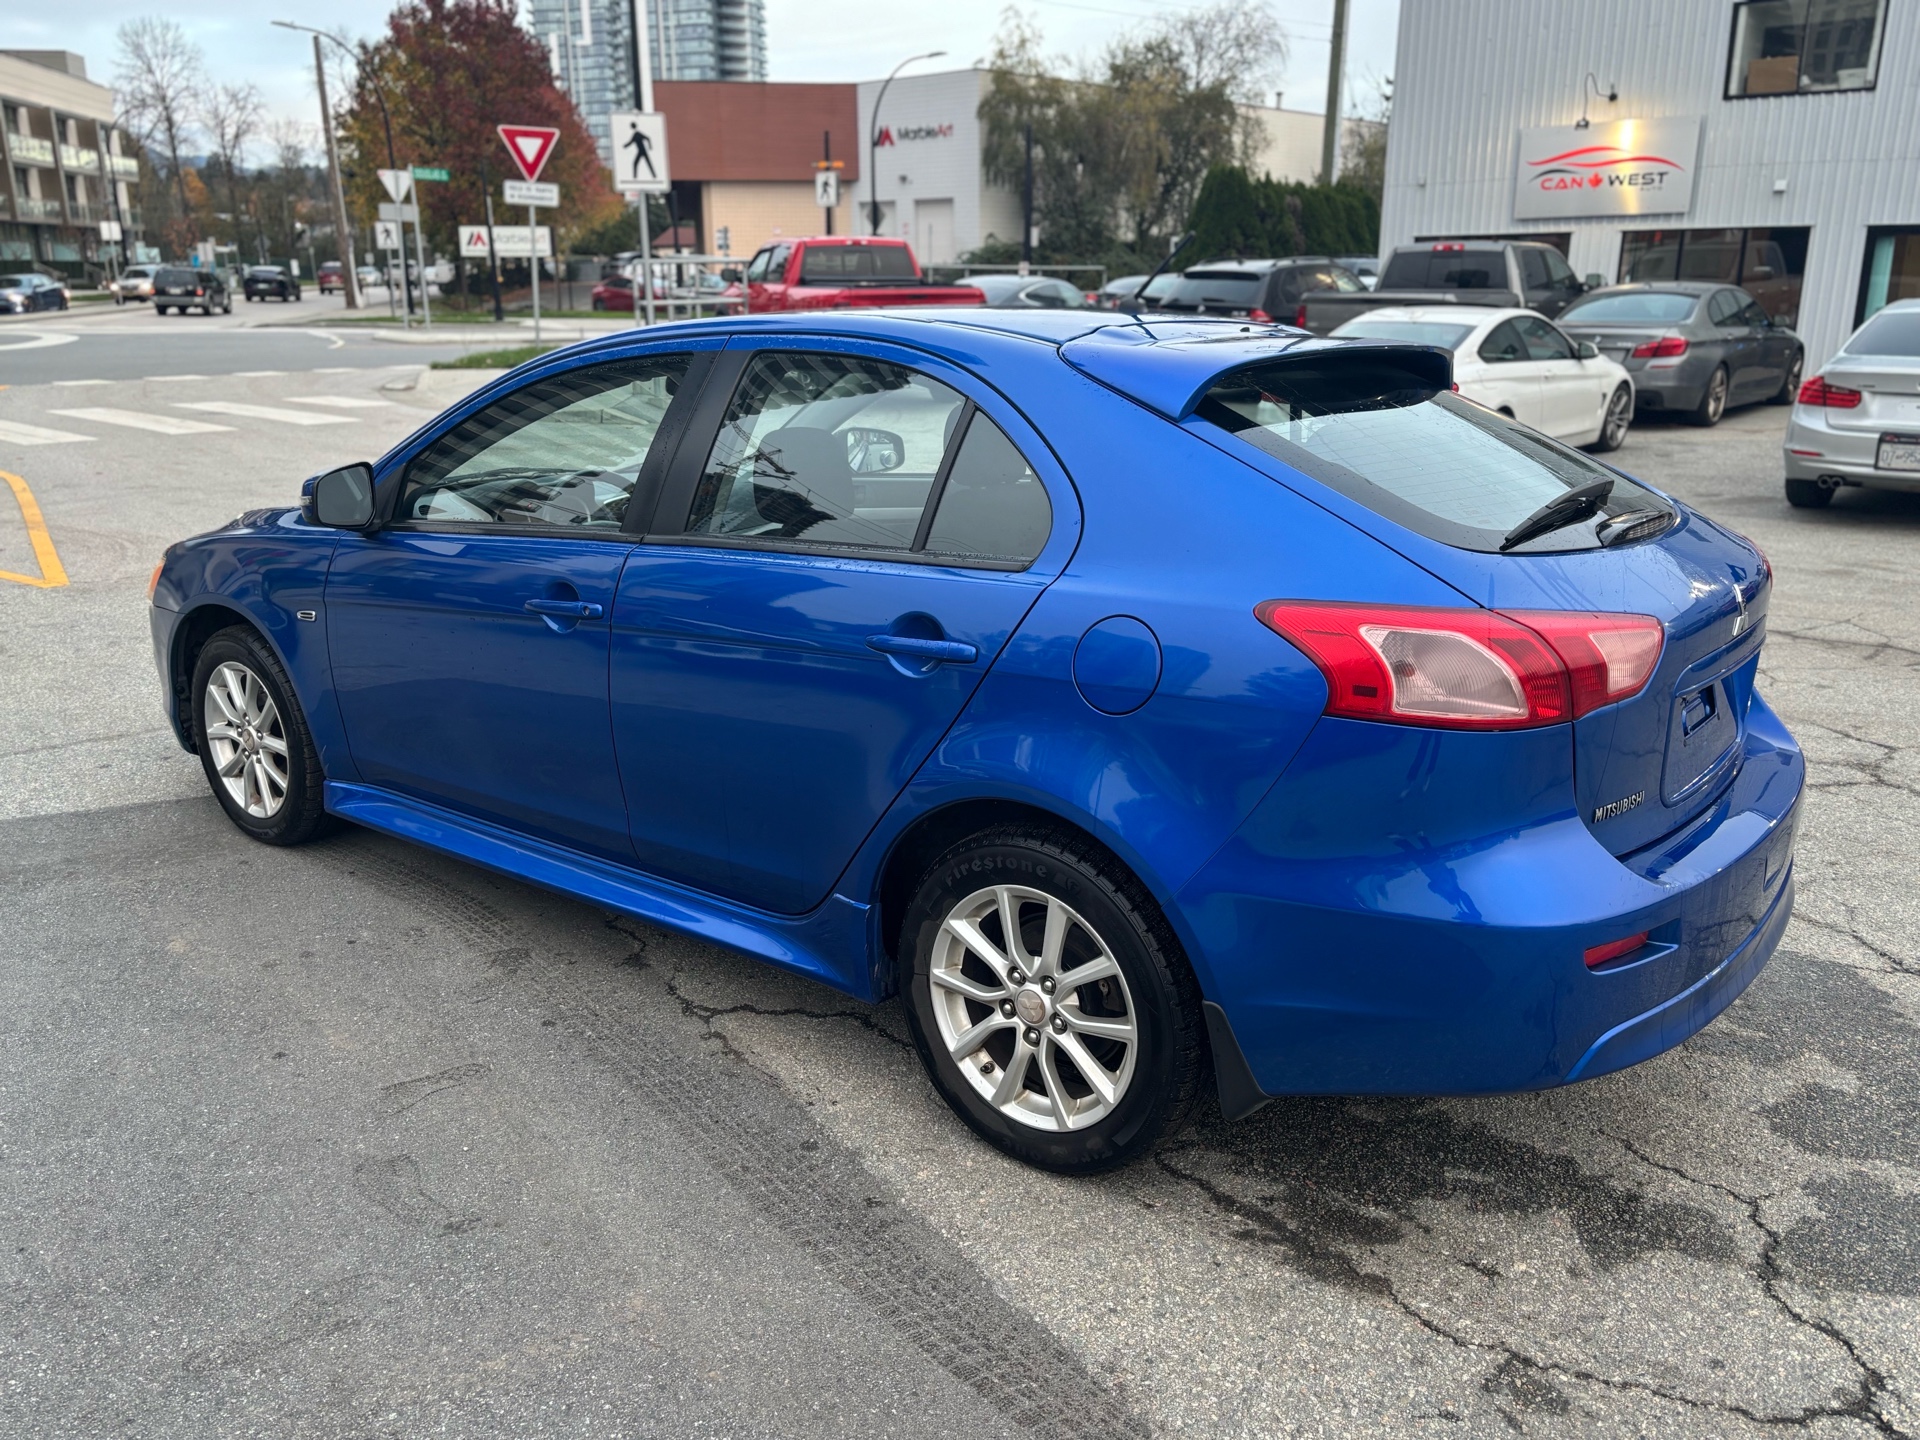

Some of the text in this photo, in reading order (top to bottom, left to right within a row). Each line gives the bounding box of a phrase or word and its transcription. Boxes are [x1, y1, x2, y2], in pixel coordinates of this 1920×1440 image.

[1540, 171, 1669, 191] CAN WEST
[1594, 790, 1645, 824] MITSUBISHI
[942, 854, 1048, 887] Firestone
